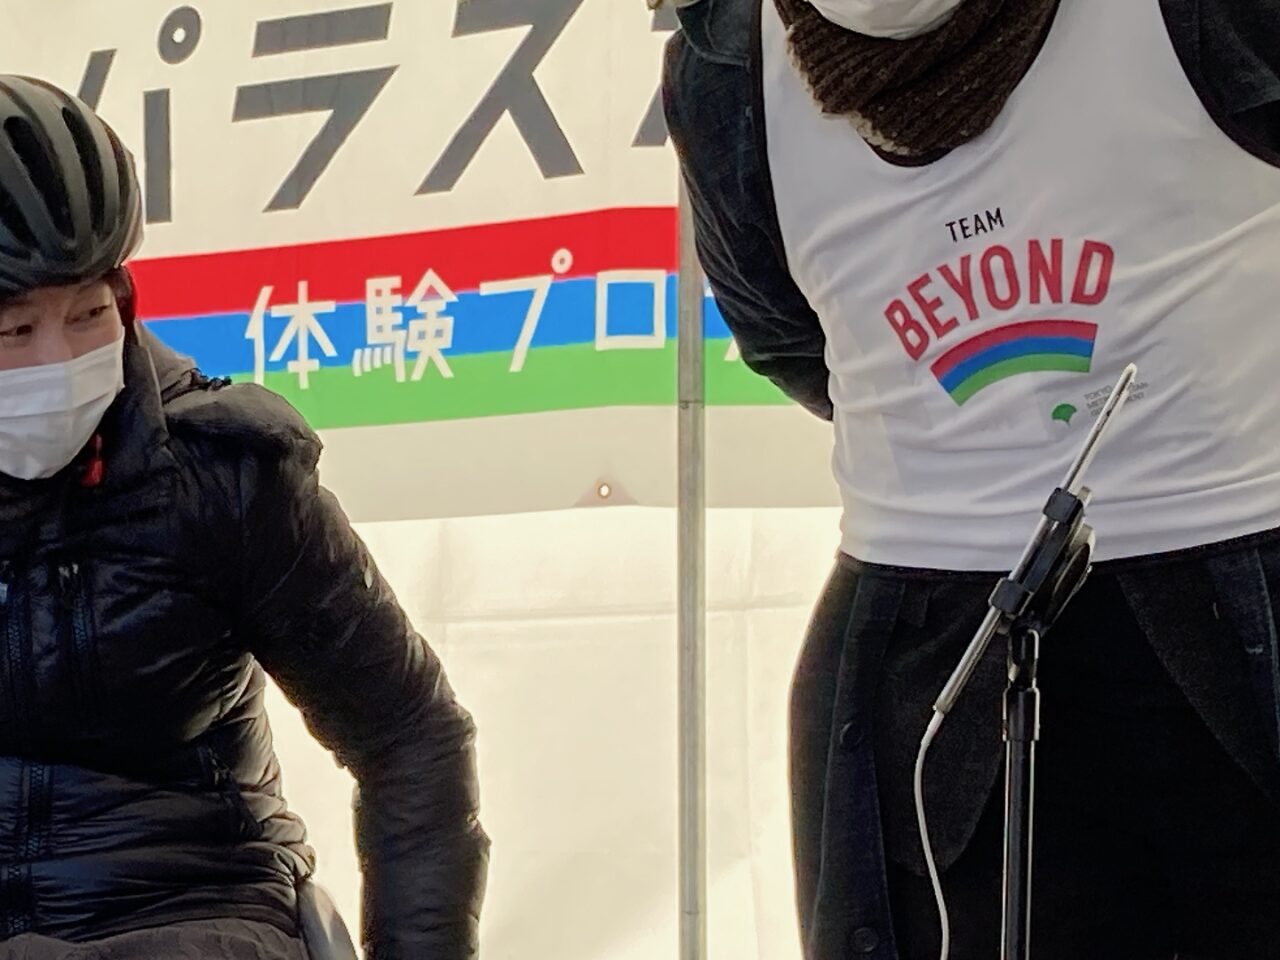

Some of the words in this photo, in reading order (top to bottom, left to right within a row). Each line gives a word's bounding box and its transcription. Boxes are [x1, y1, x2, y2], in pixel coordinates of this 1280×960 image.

[75, 0, 678, 224] パラス
[945, 207, 1005, 243] TEAM
[244, 248, 743, 390] 体験プロ
[884, 238, 1114, 362] BEYOND
